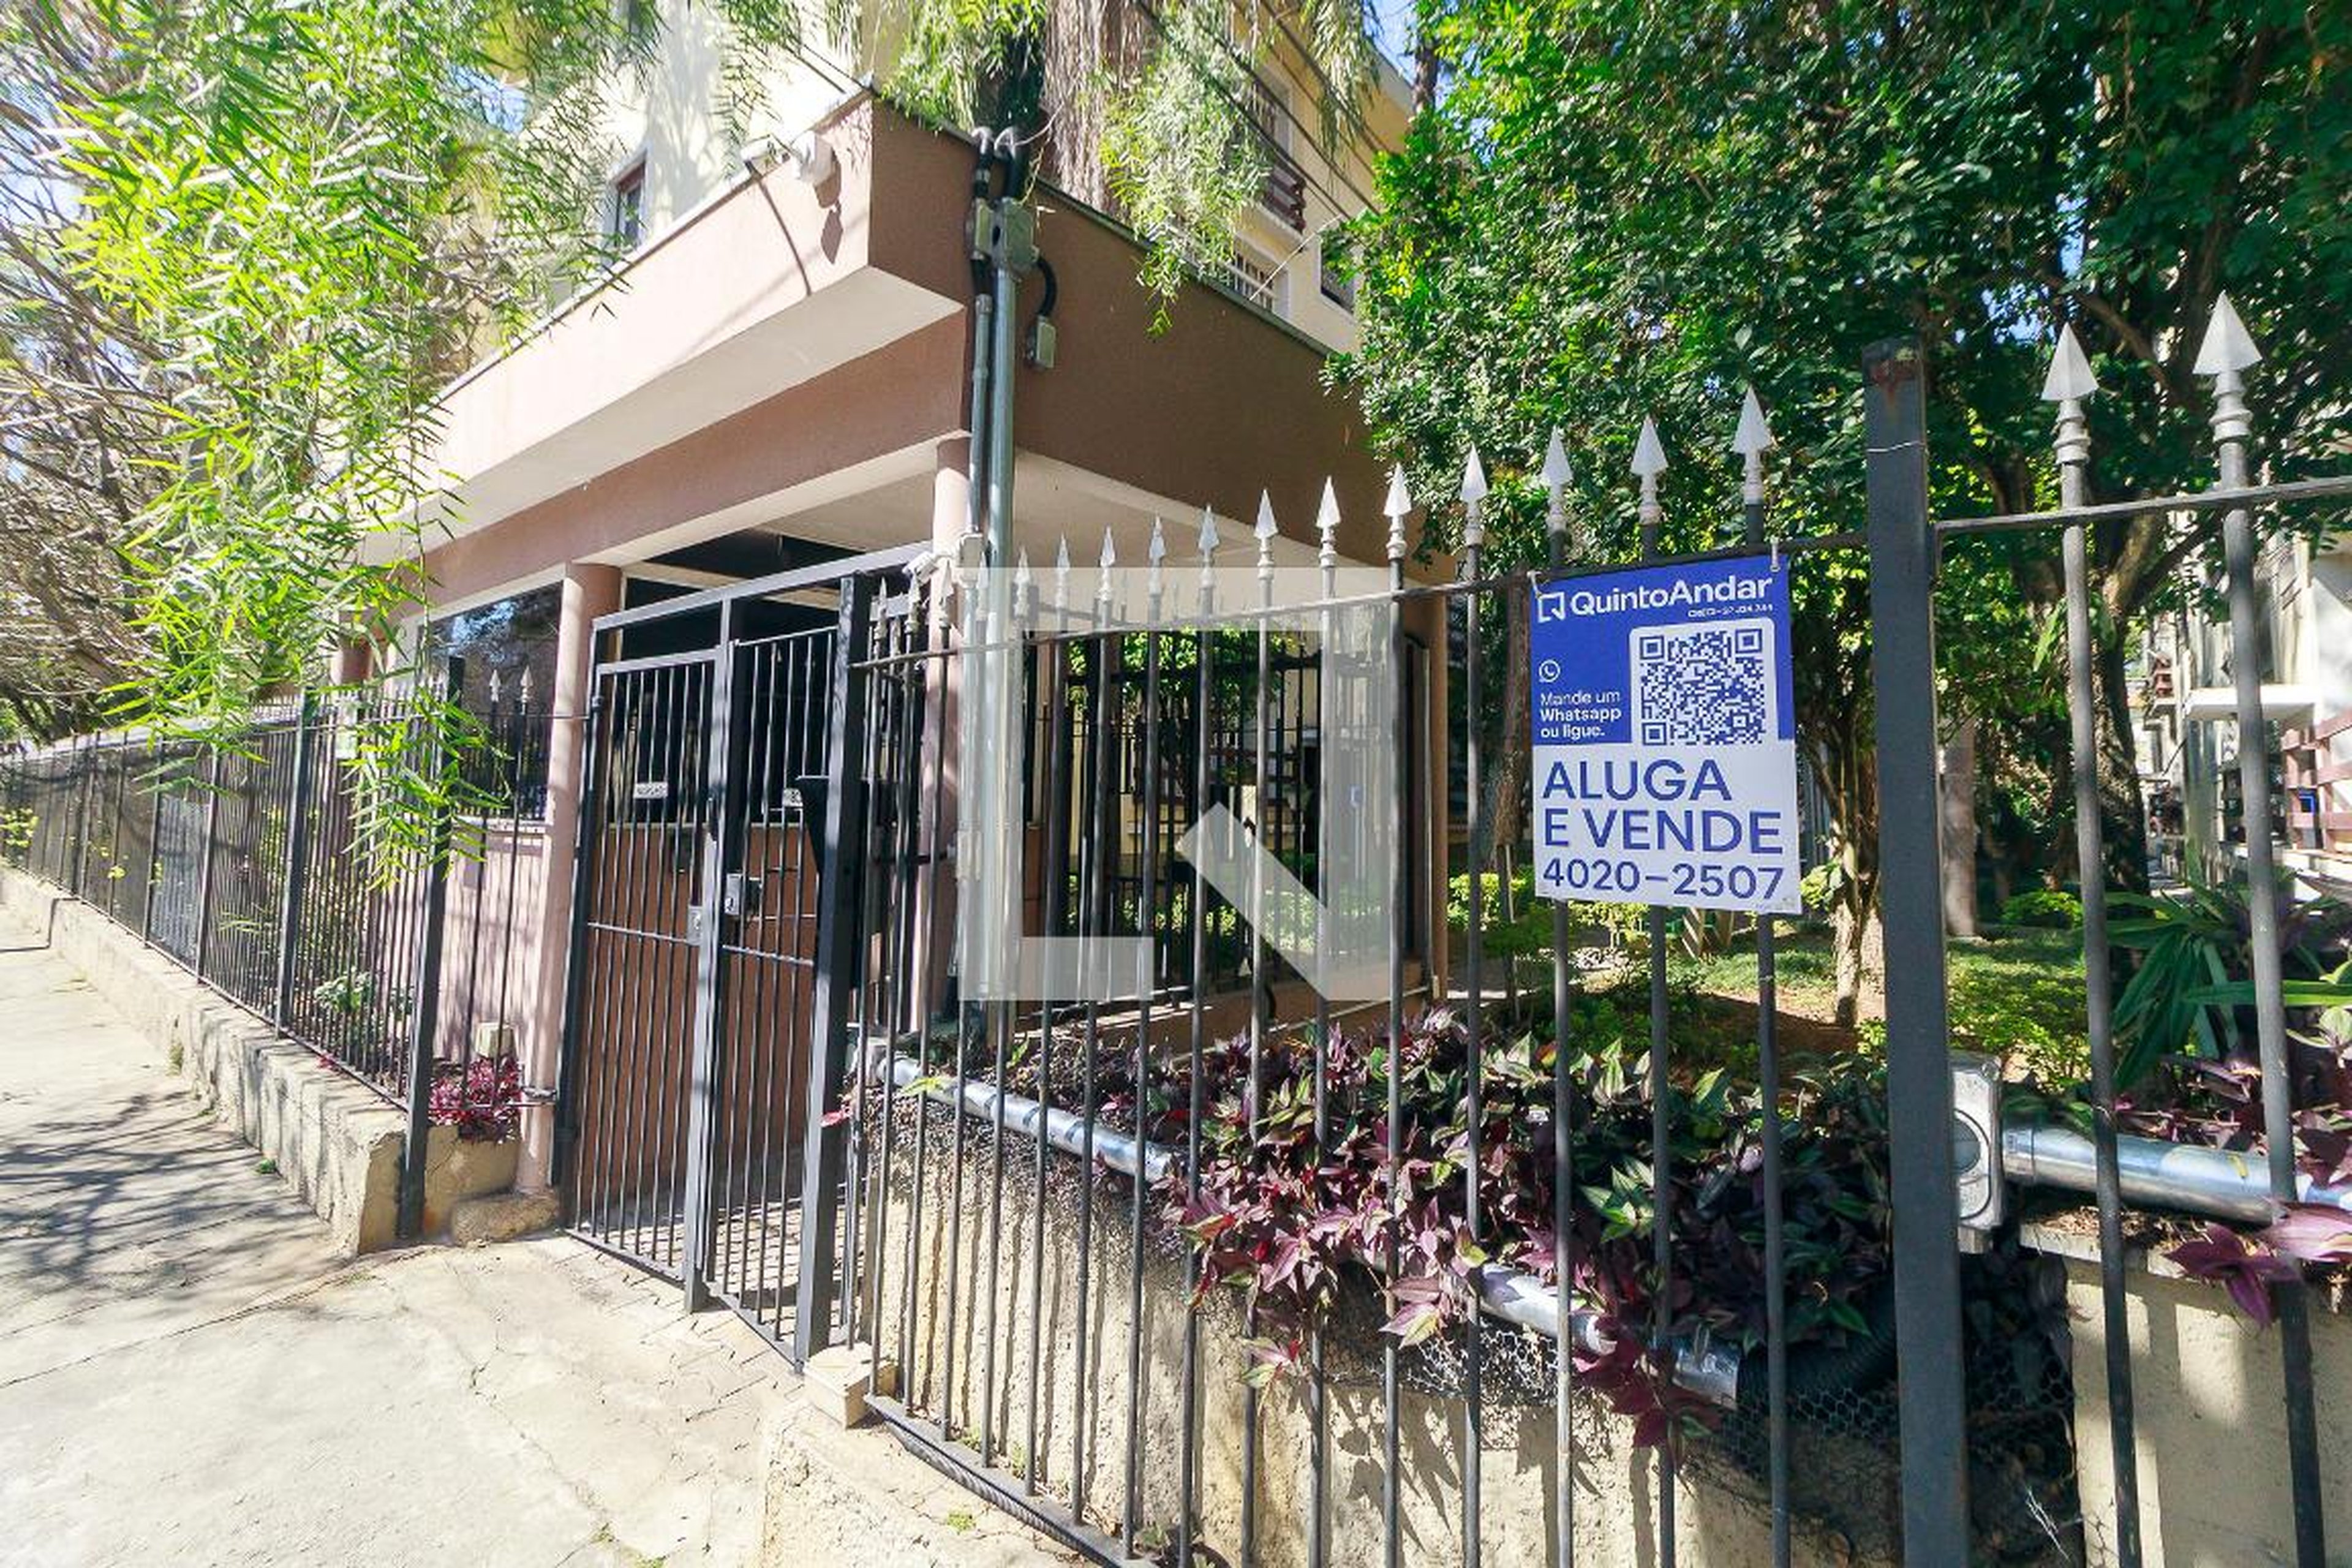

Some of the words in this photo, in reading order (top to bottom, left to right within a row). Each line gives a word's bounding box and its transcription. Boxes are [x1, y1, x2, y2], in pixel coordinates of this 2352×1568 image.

[1570, 575, 1773, 616] QuintoAndar
[1540, 691, 1591, 705] Mande
[1596, 692, 1620, 704] um
[1540, 708, 1621, 723] Whatsapp
[1540, 727, 1559, 737] ou
[1543, 760, 1732, 801] ALUGA
[1545, 809, 1569, 846] E
[1583, 809, 1782, 854] VENDE
[1544, 858, 1784, 899] 4020-2507
